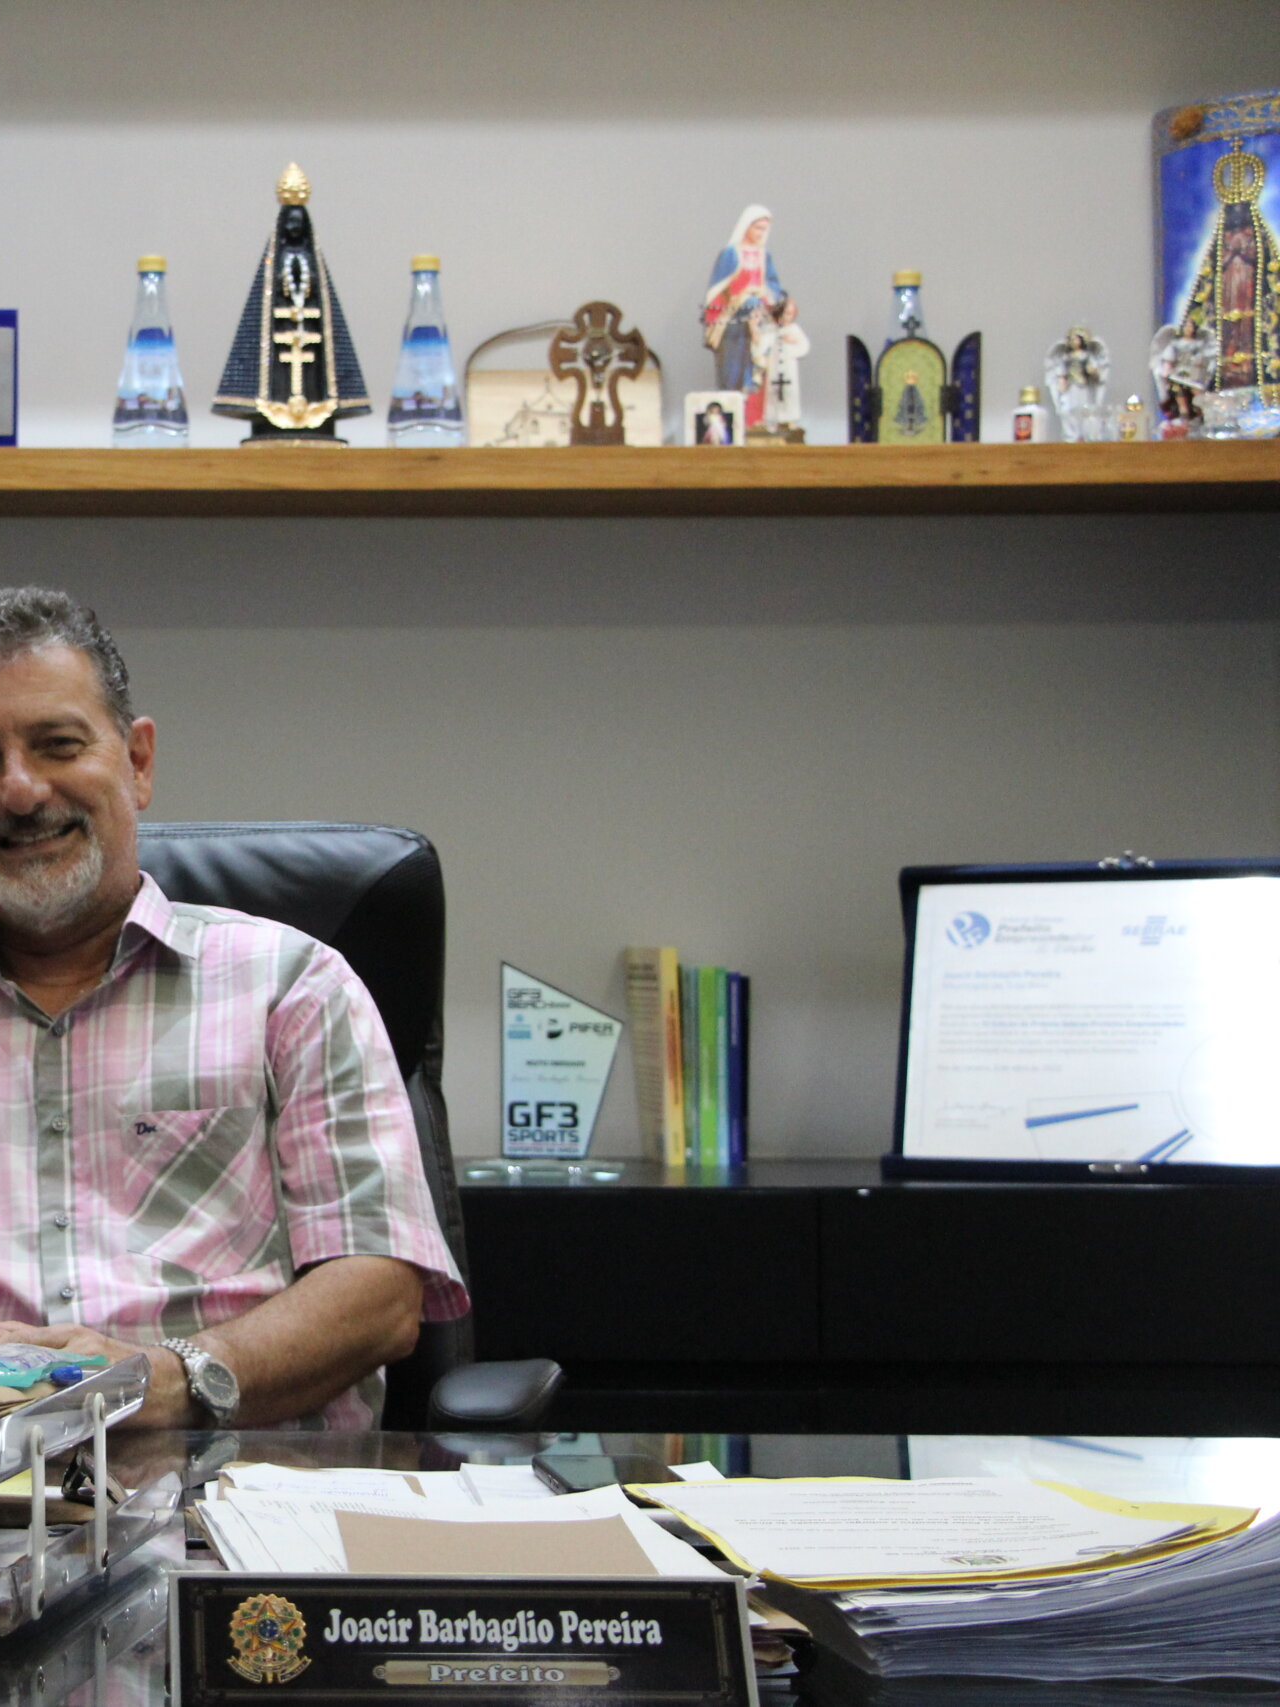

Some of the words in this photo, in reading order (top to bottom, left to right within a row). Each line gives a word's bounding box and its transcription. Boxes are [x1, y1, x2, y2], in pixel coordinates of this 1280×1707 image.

[508, 1101, 579, 1128] GF3
[507, 1129, 579, 1142] SPORTS
[324, 1609, 413, 1644] Joacir
[419, 1610, 554, 1652] Barbaglio
[561, 1610, 662, 1645] Pereira
[428, 1663, 565, 1685] Prefeito
